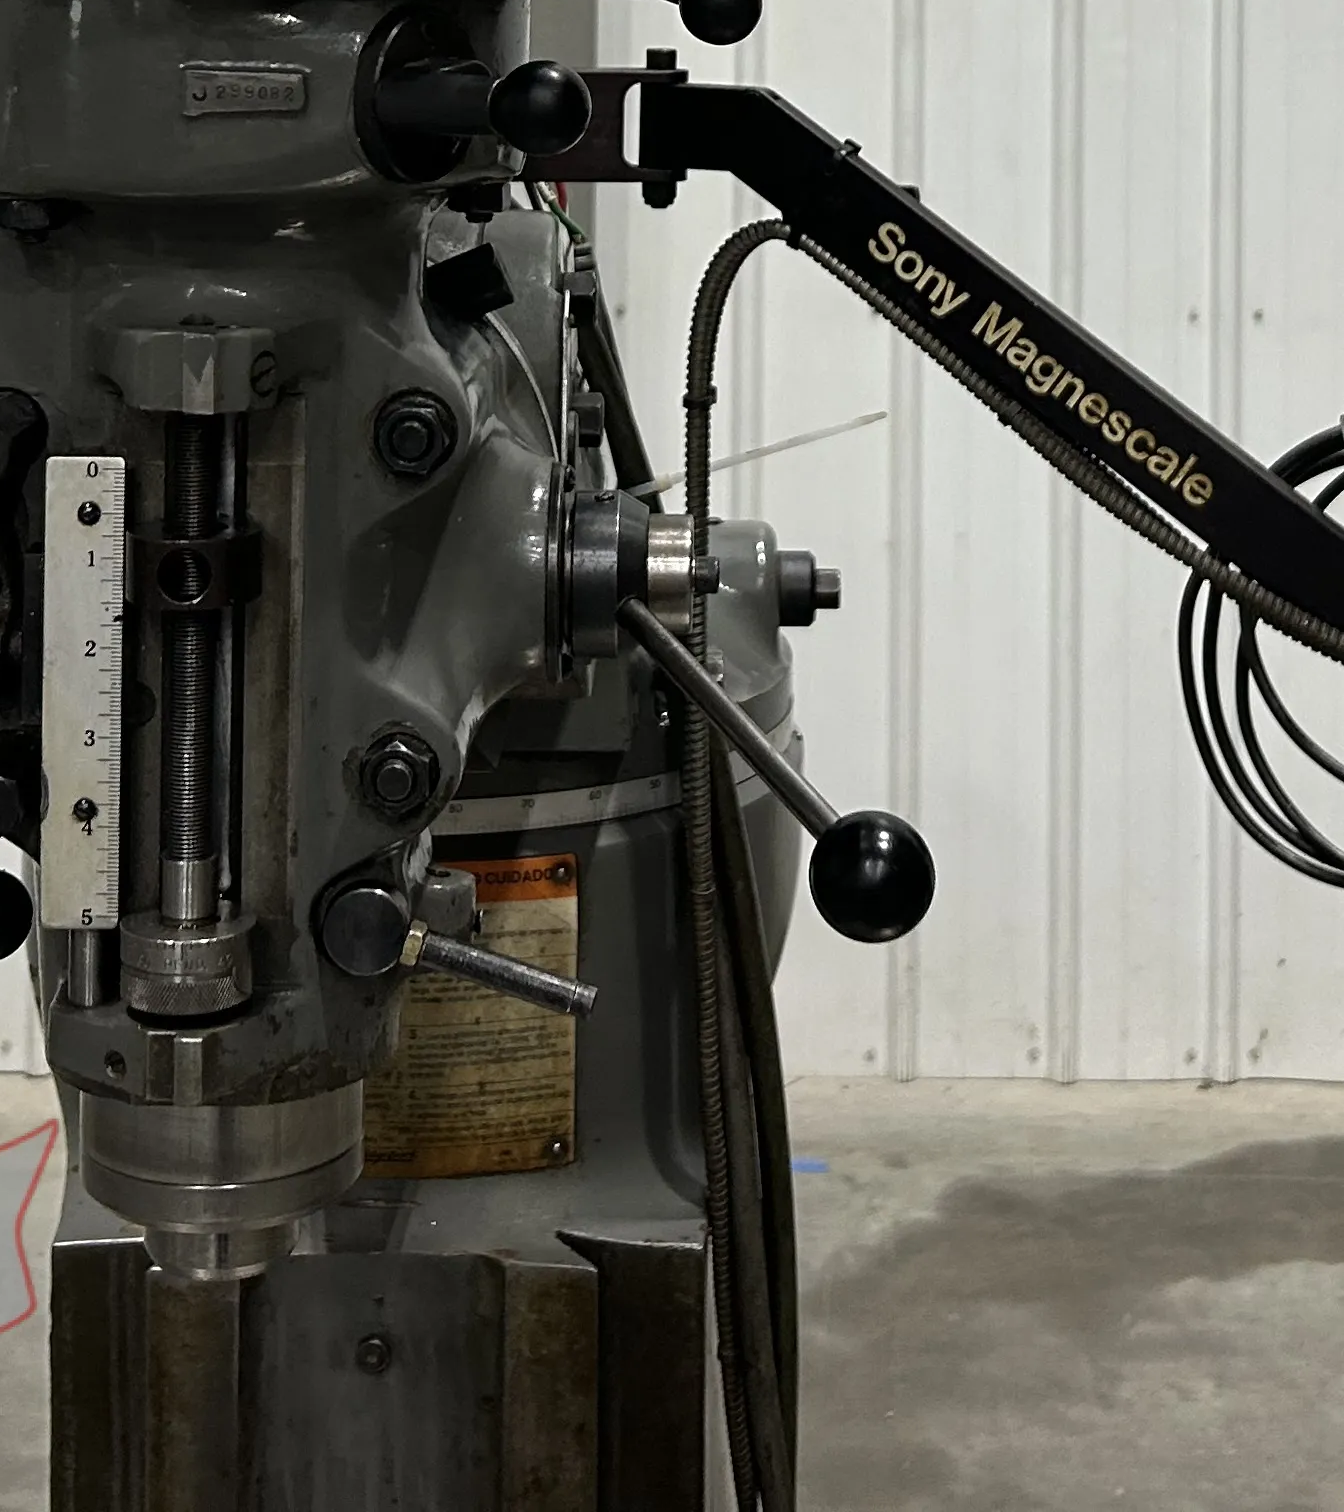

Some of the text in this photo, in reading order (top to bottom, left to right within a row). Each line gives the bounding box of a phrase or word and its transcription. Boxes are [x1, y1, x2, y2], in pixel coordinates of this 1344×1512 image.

[192, 85, 206, 101] J
[867, 221, 1213, 507] Sony Magnescale
[87, 462, 99, 478] 0
[87, 551, 96, 567] 1
[84, 640, 96, 657] 2
[83, 730, 96, 747] 3
[82, 819, 93, 836] 4
[81, 908, 93, 925] 5
